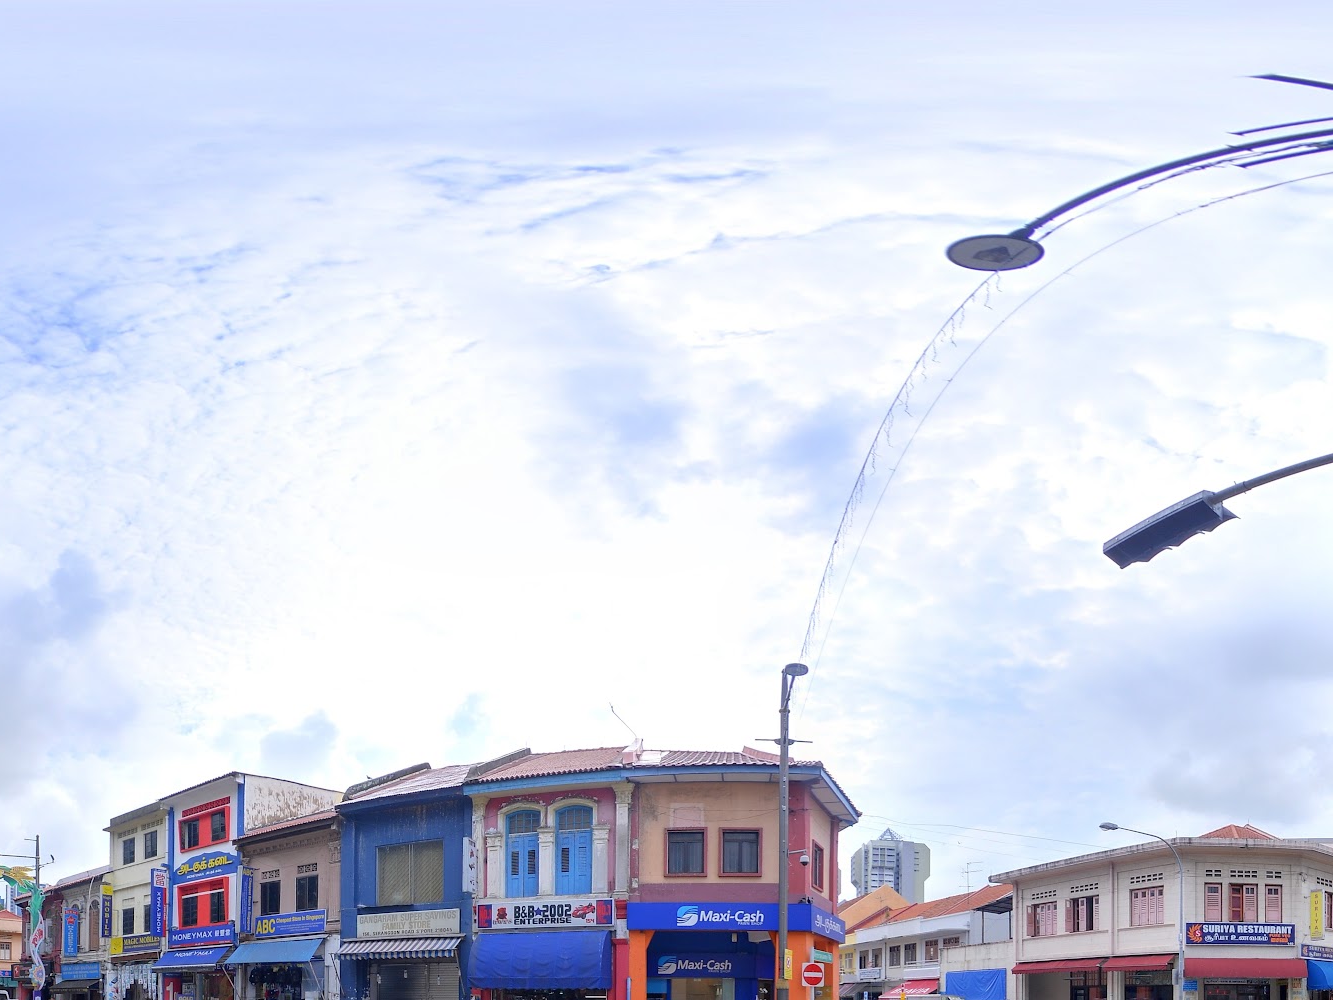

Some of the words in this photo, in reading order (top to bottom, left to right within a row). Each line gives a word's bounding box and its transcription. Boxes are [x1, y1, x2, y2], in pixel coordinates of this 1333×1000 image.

[243, 868, 253, 877] ABC
[514, 904, 534, 919] B&B
[542, 903, 572, 917] 2002
[359, 914, 398, 925] GANGARAM
[400, 912, 422, 922] SUPER
[425, 910, 456, 920] SAVINGS
[514, 916, 572, 925] ENTERPRISE
[699, 910, 765, 923] Maxi-Cash
[256, 918, 276, 935] ABC
[382, 922, 406, 930] FAMILY
[408, 920, 431, 929] STORE
[1203, 925, 1234, 933] SURIYA
[1237, 925, 1292, 934] RESTAURANT
[172, 931, 213, 941] MONEYMAX
[174, 950, 215, 958] MONEYMAX
[677, 959, 732, 971] Maxi-Cash
